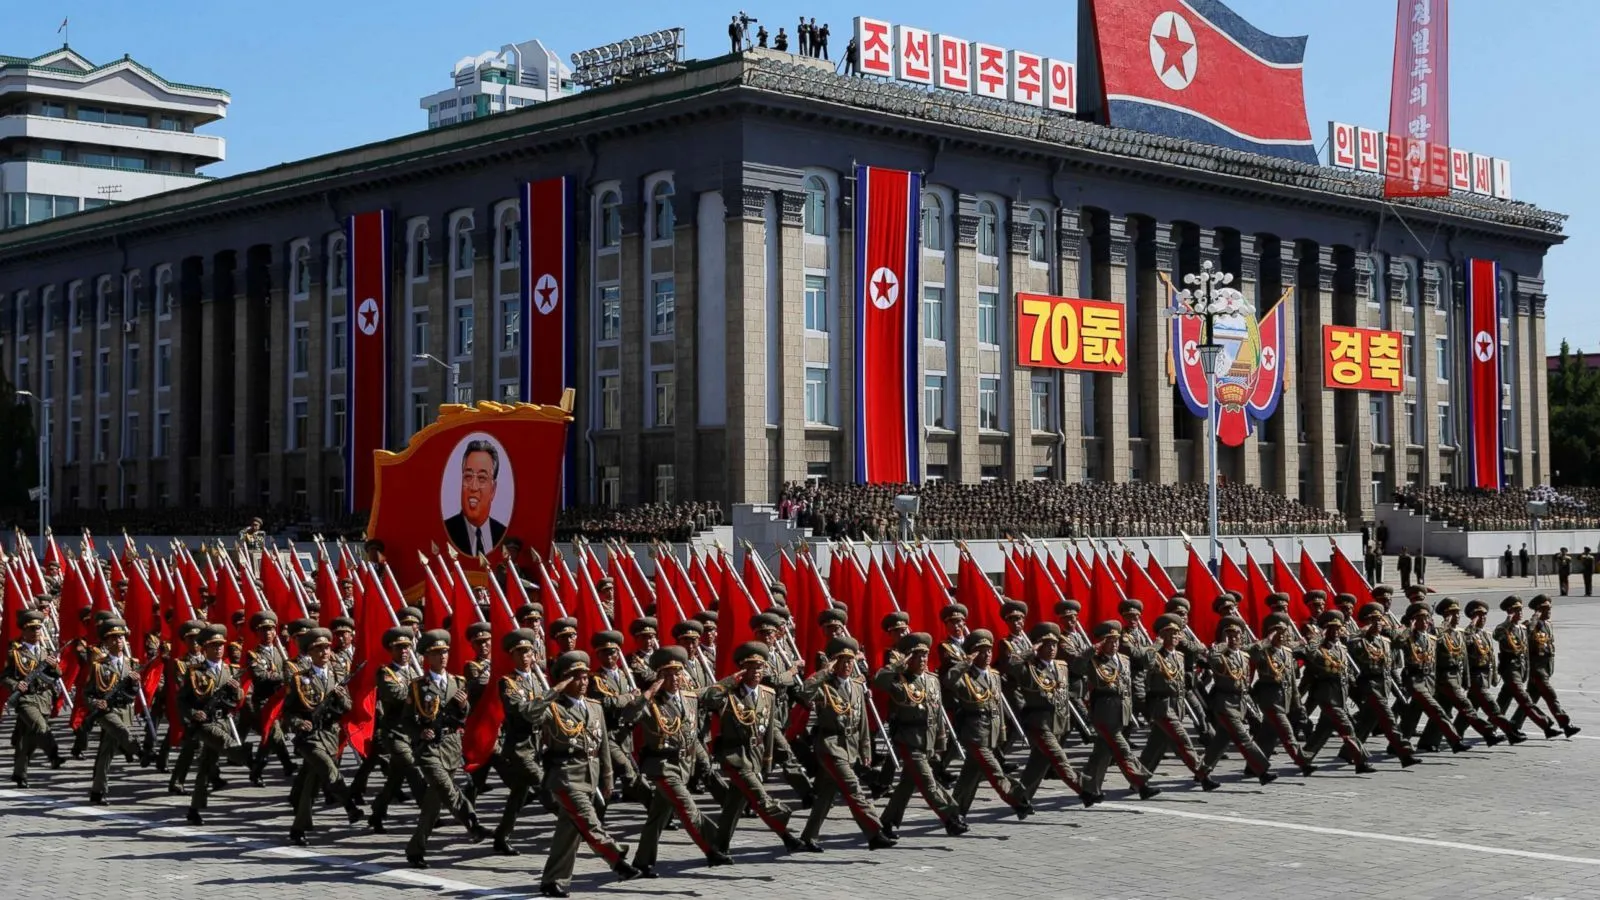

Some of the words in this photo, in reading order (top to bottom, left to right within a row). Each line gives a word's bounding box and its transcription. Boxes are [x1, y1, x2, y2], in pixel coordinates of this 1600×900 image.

[864, 21, 1074, 109] 조선민주주의
[1022, 299, 1123, 366] 70돐
[1331, 330, 1401, 387] 경축
